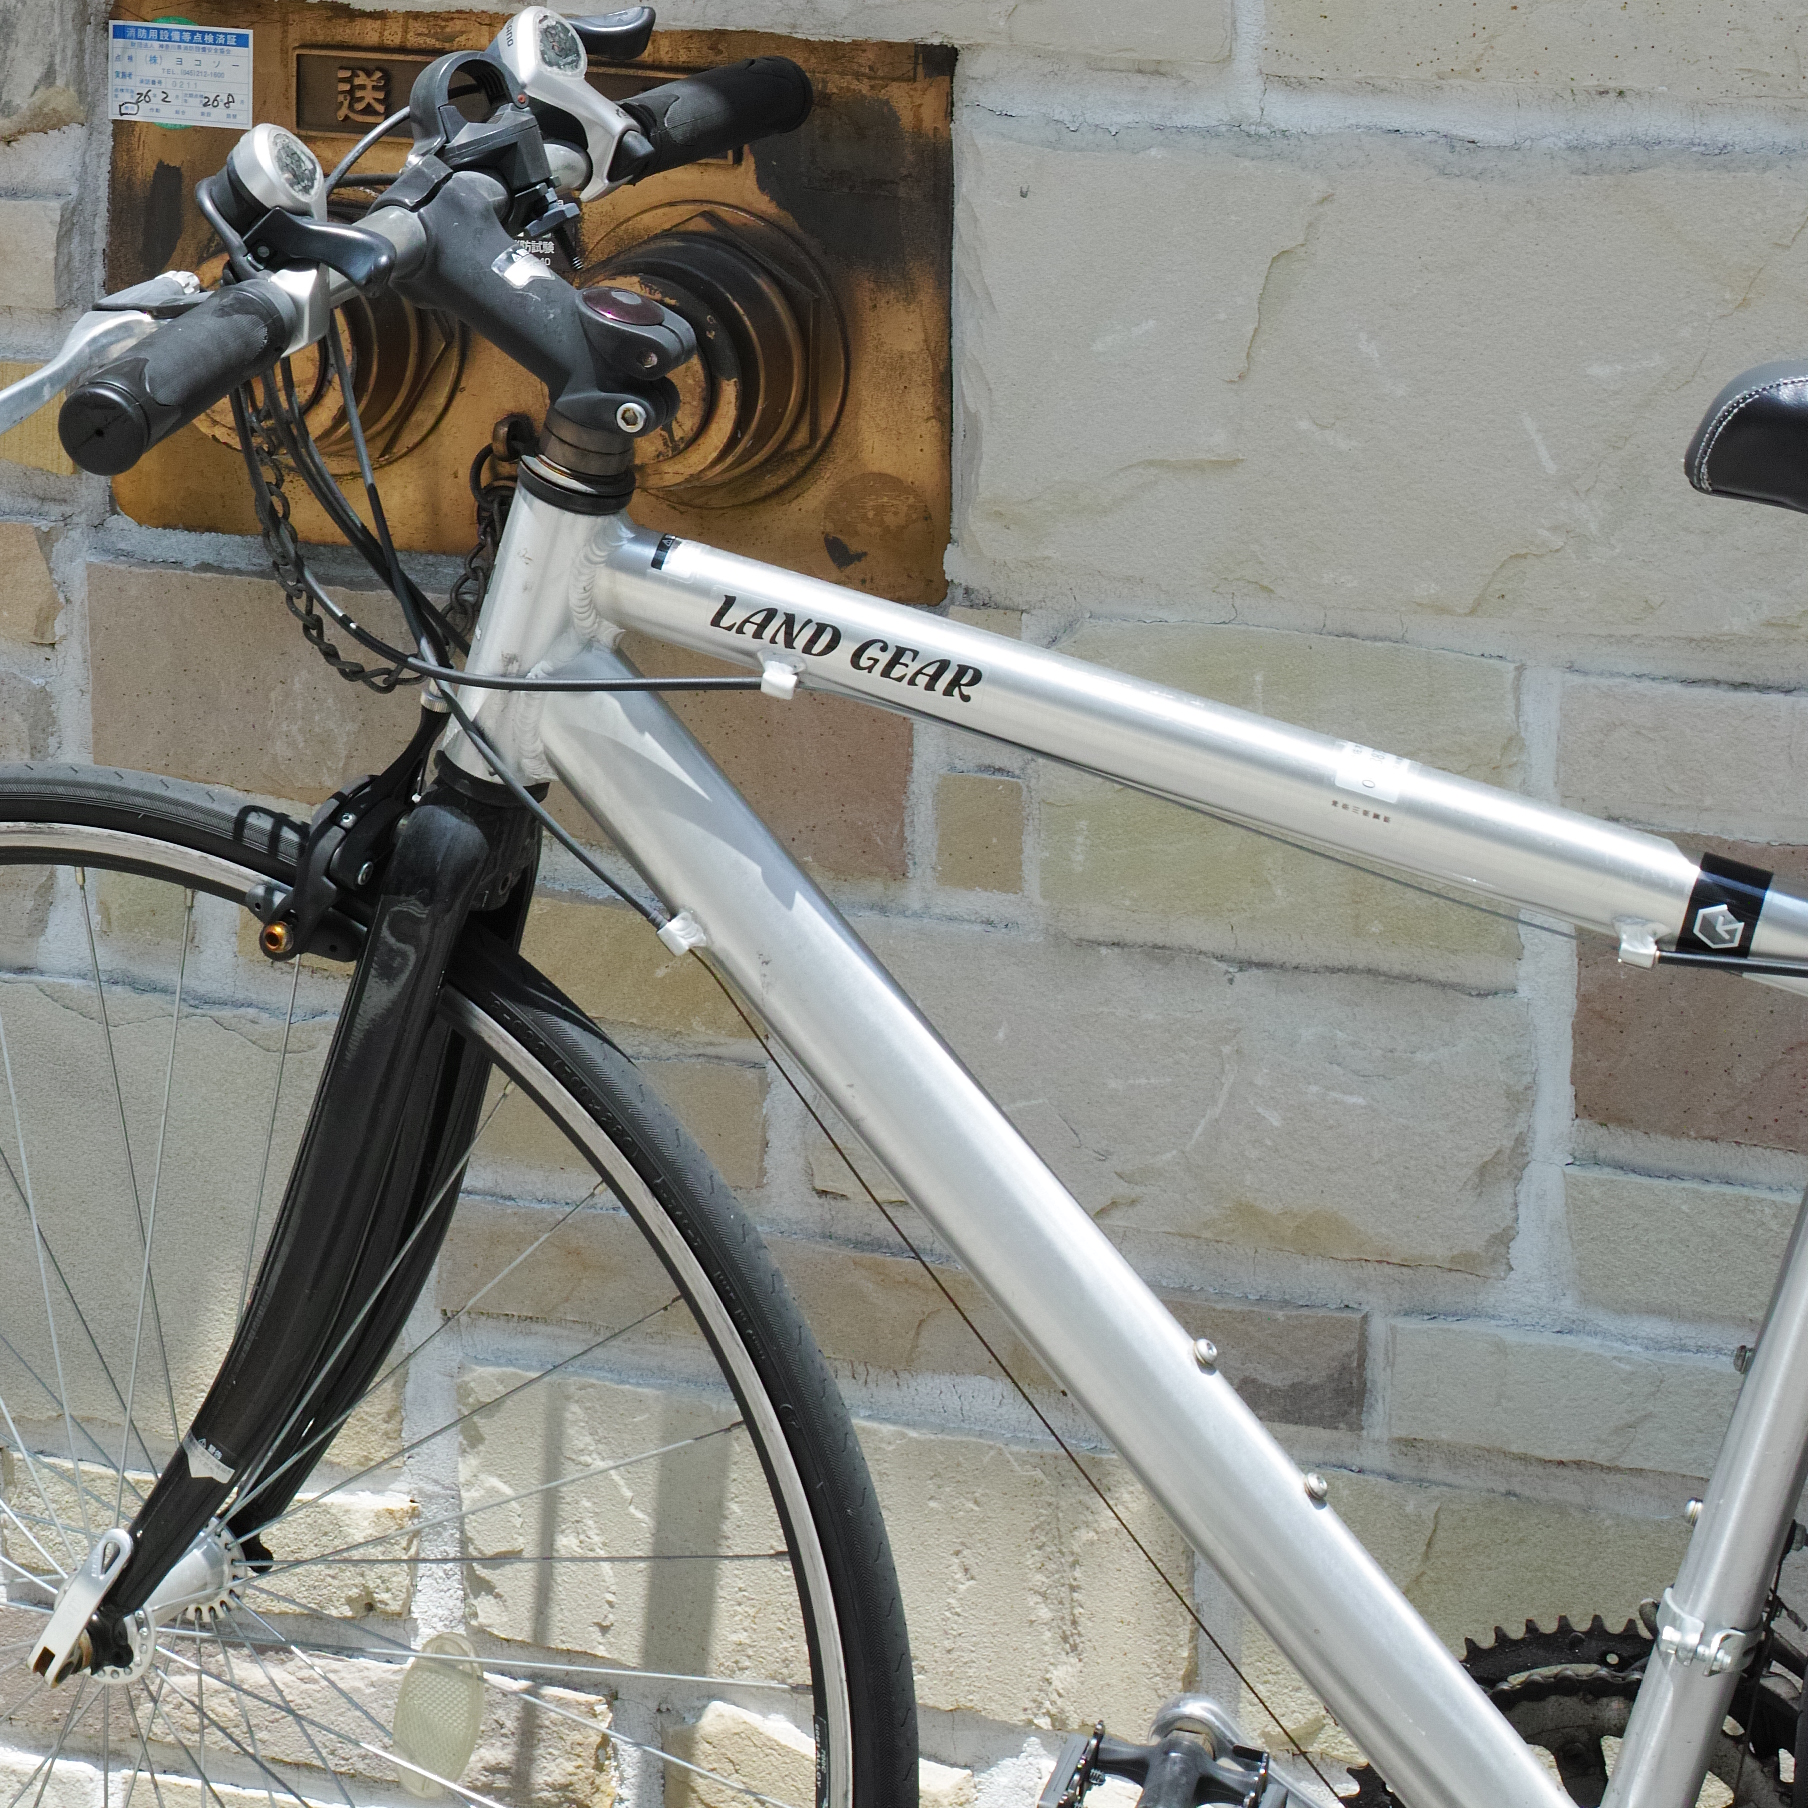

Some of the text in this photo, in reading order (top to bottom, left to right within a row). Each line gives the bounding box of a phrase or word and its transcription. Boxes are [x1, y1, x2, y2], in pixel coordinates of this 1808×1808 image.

[125, 28, 237, 45] 消防用設備等点検済証
[136, 89, 152, 104] 26
[161, 90, 171, 103] 2
[202, 94, 220, 108] 26
[337, 67, 386, 123] 送
[710, 594, 983, 703] LAND GEAR
